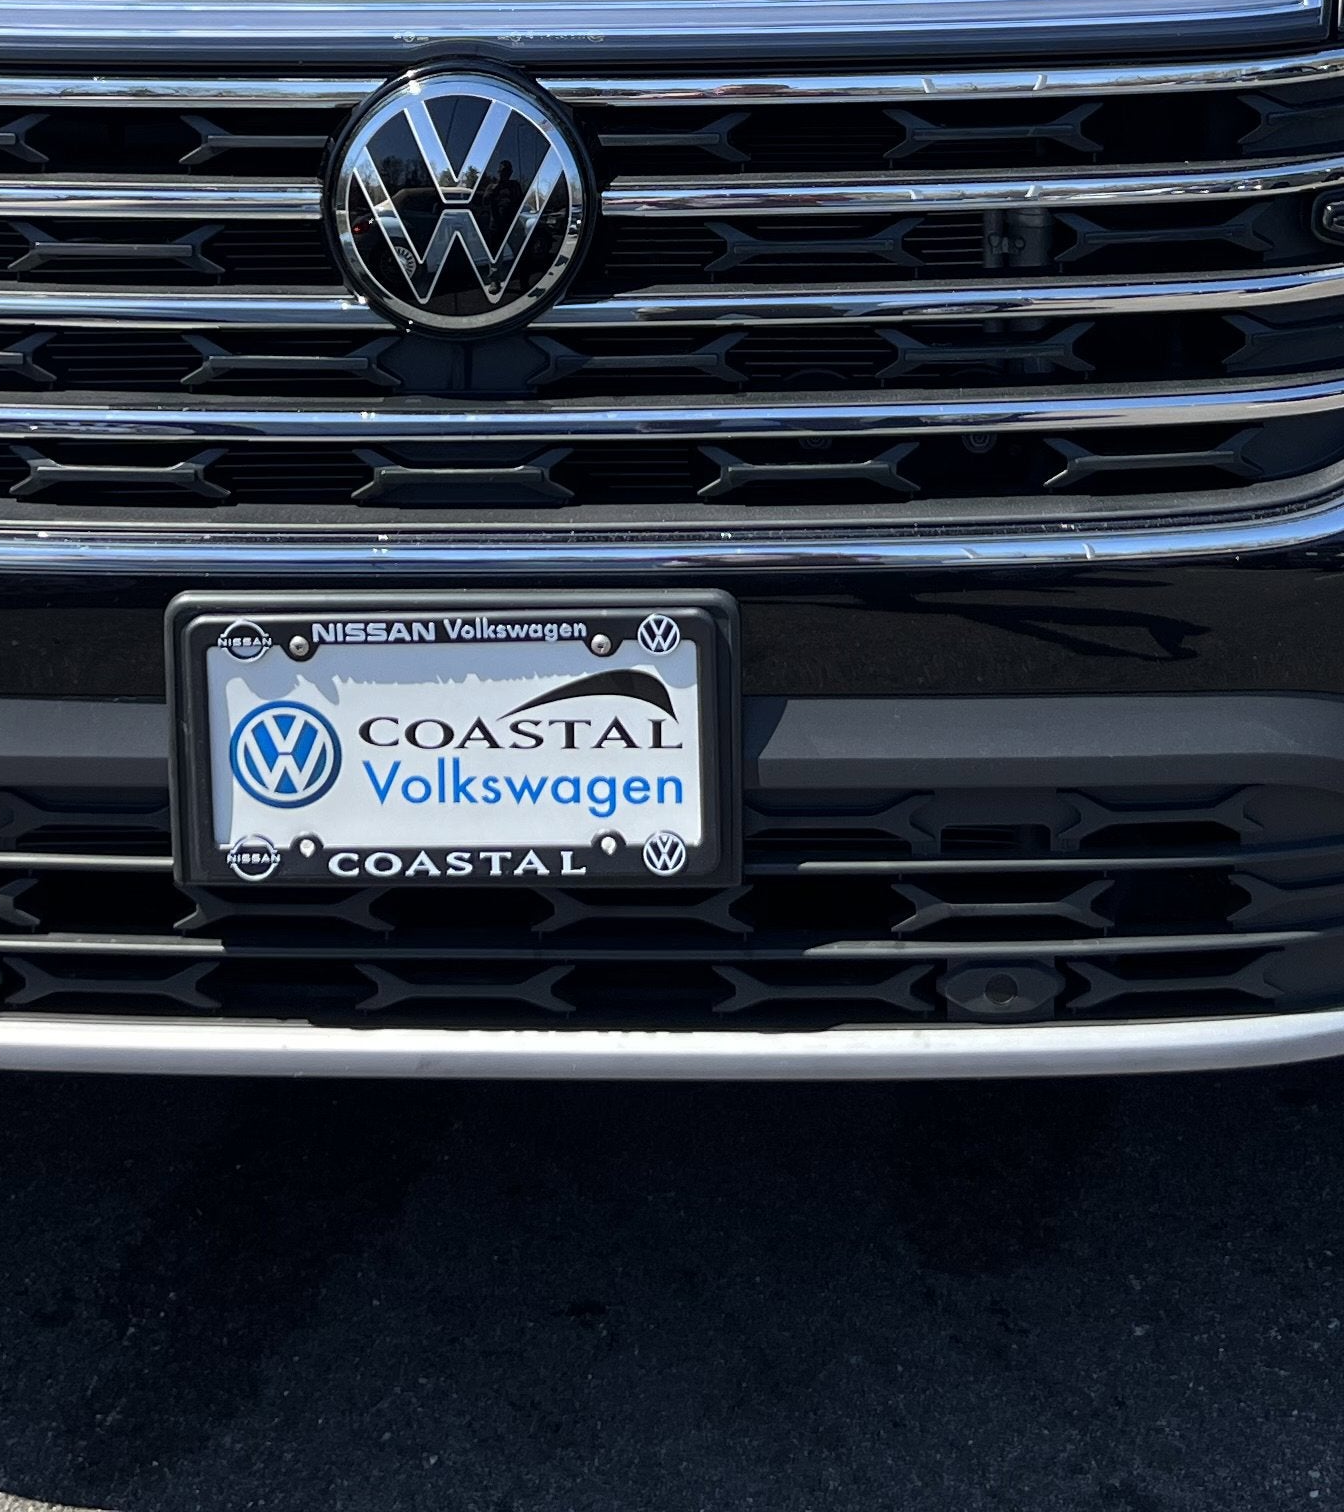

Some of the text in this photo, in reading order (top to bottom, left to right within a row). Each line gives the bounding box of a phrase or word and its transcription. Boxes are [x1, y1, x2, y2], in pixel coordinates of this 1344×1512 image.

[217, 636, 272, 647] NISSAN
[311, 617, 588, 643] NISSAN Volkswagen
[358, 716, 683, 750] COASTAL
[361, 757, 684, 818] Volkswagen
[226, 853, 281, 864] NISSAN
[327, 849, 587, 877] COASTAL
